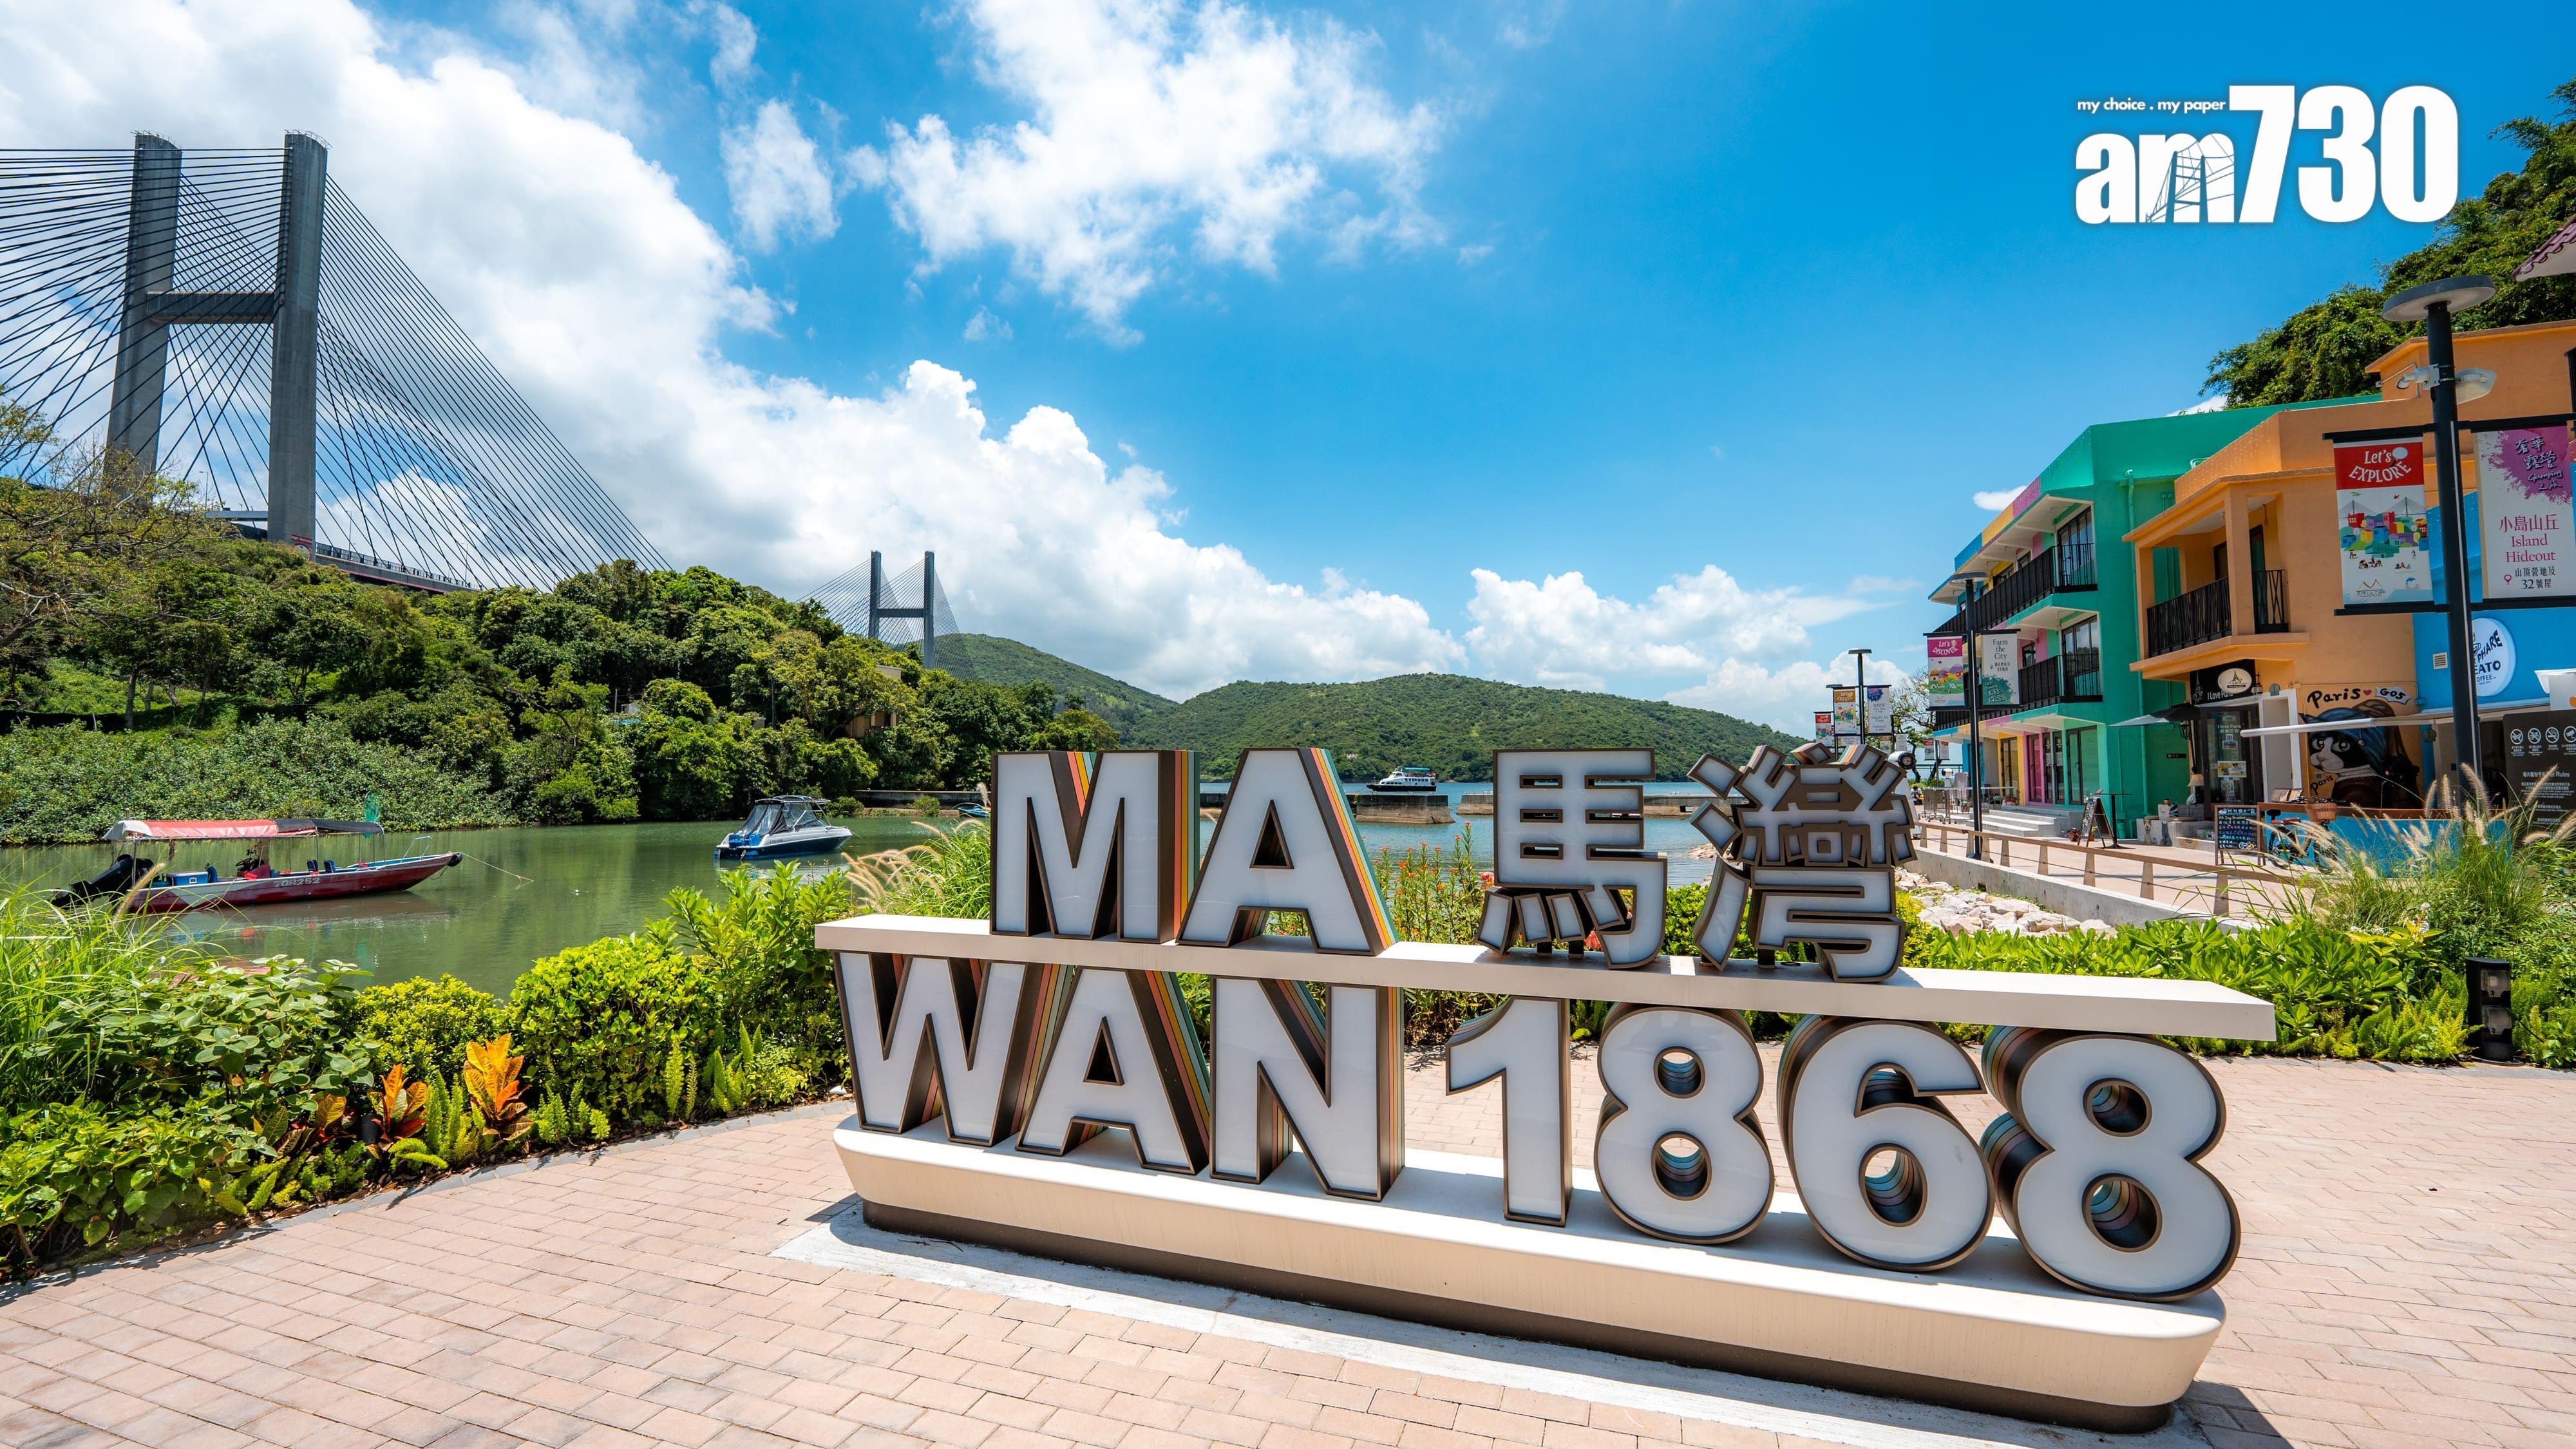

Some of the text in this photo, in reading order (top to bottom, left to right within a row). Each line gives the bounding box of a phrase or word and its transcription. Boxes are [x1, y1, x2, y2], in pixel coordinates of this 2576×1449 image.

[2364, 450, 2392, 464] Let's
[2349, 461, 2412, 482] EXPLORE
[2499, 514, 2559, 533] 小島山丘
[2511, 533, 2548, 547] Island
[2506, 550, 2556, 562] Hideout
[2515, 566, 2555, 578] 山頂營地及
[1932, 647, 1958, 655] DISCOVER
[2477, 630, 2503, 663] PHARE
[2474, 660, 2501, 675] EATO
[2476, 674, 2493, 683] OFFEE
[2210, 690, 2221, 700] Love
[2307, 688, 2361, 708] Paris
[2310, 775, 2333, 795] Paris
[990, 747, 1390, 956] MA
[1475, 744, 1917, 983] 馬灣
[834, 951, 2241, 1302] WAN 1868
